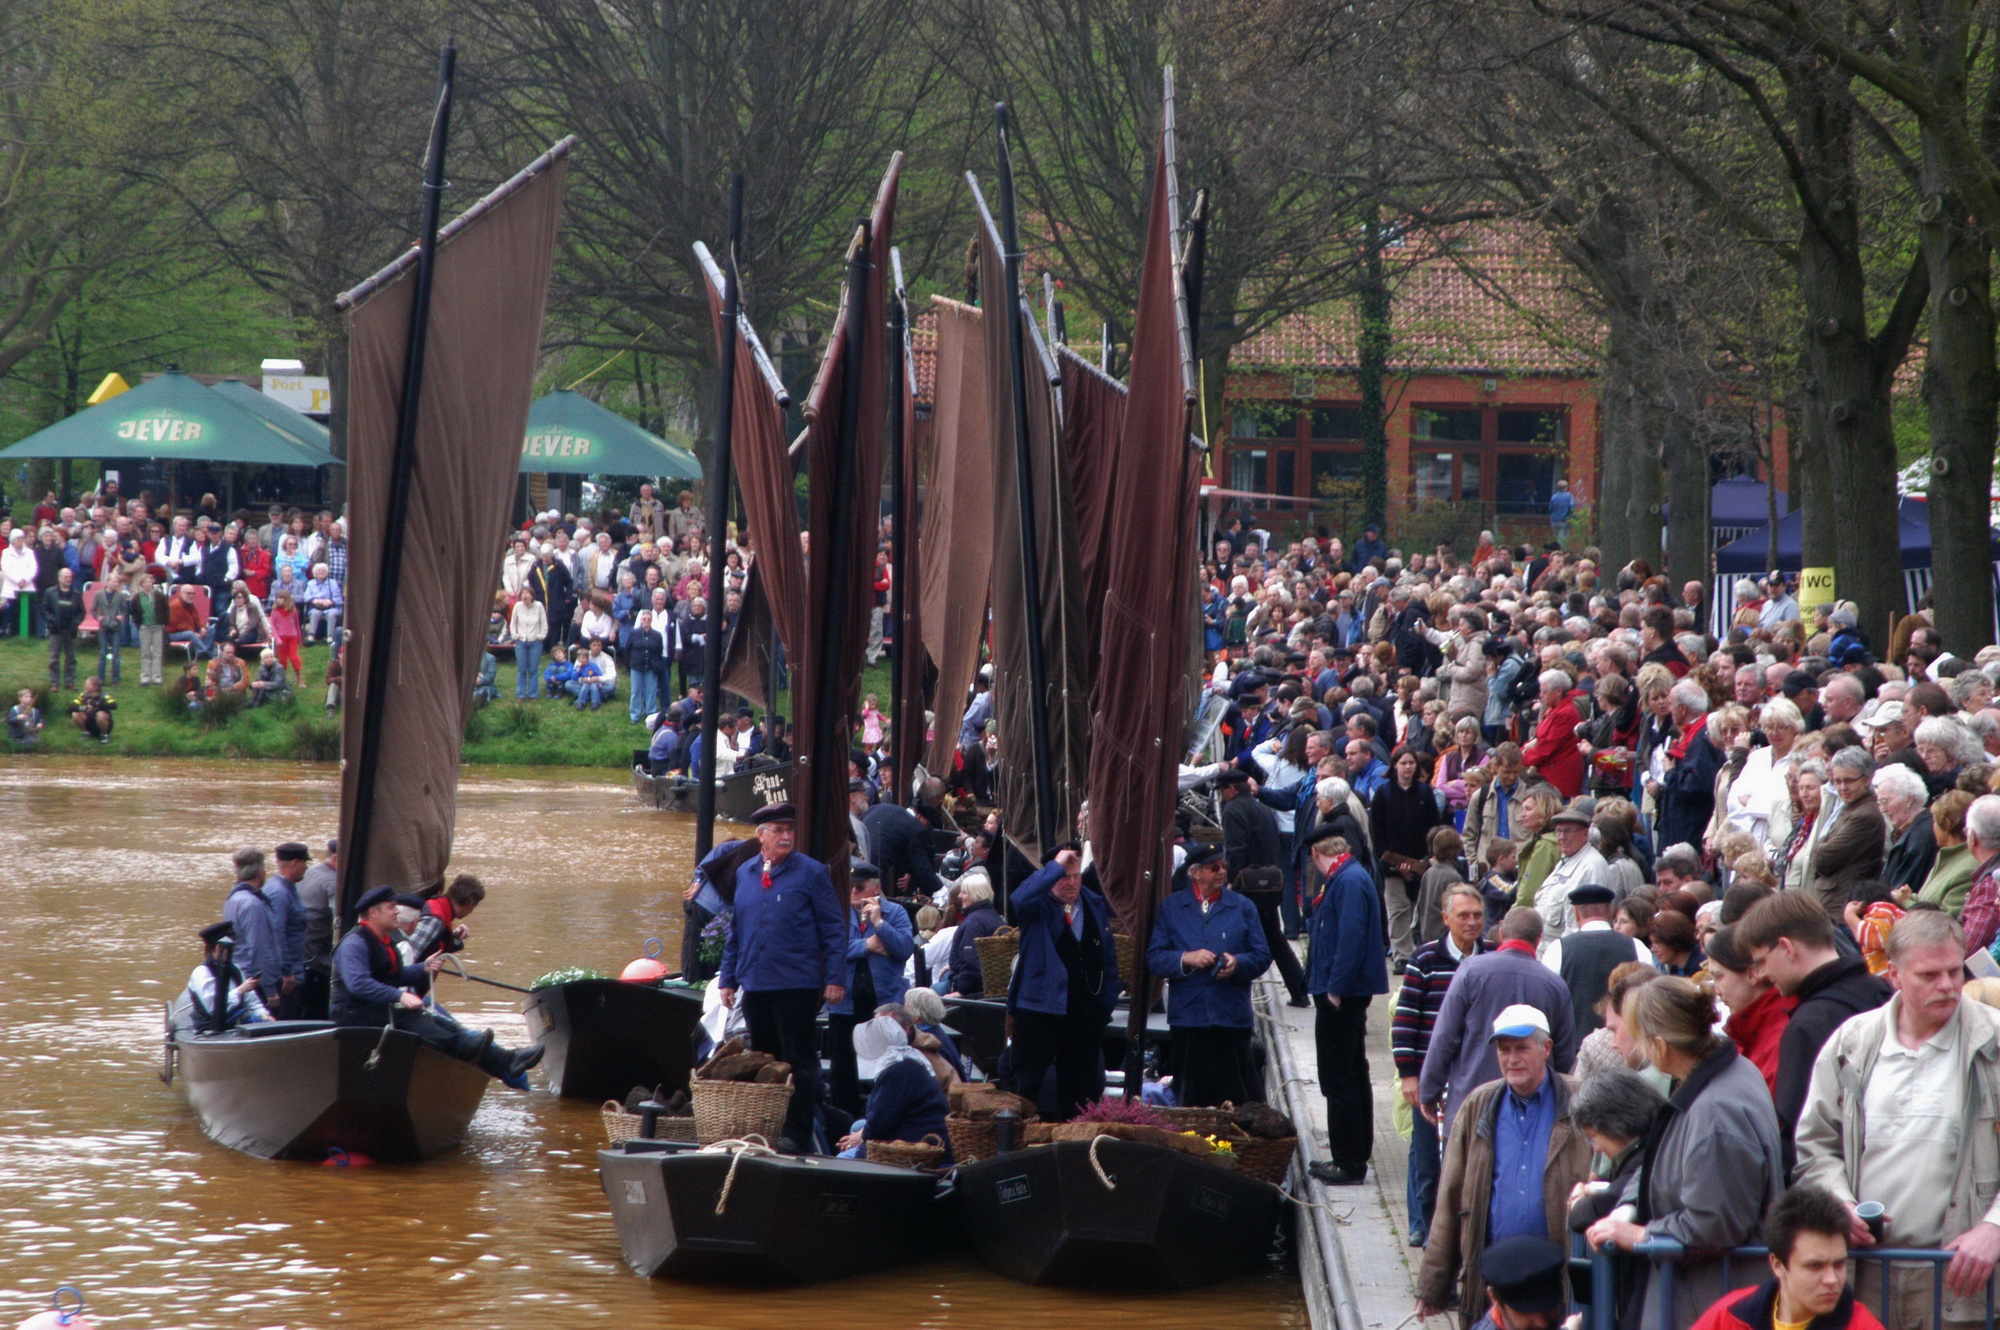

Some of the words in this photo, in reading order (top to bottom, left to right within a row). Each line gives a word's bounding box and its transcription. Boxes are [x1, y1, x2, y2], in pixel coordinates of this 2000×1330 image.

[271, 378, 304, 391] Port
[117, 418, 203, 442] JEVER
[1807, 575, 1832, 588] WC
